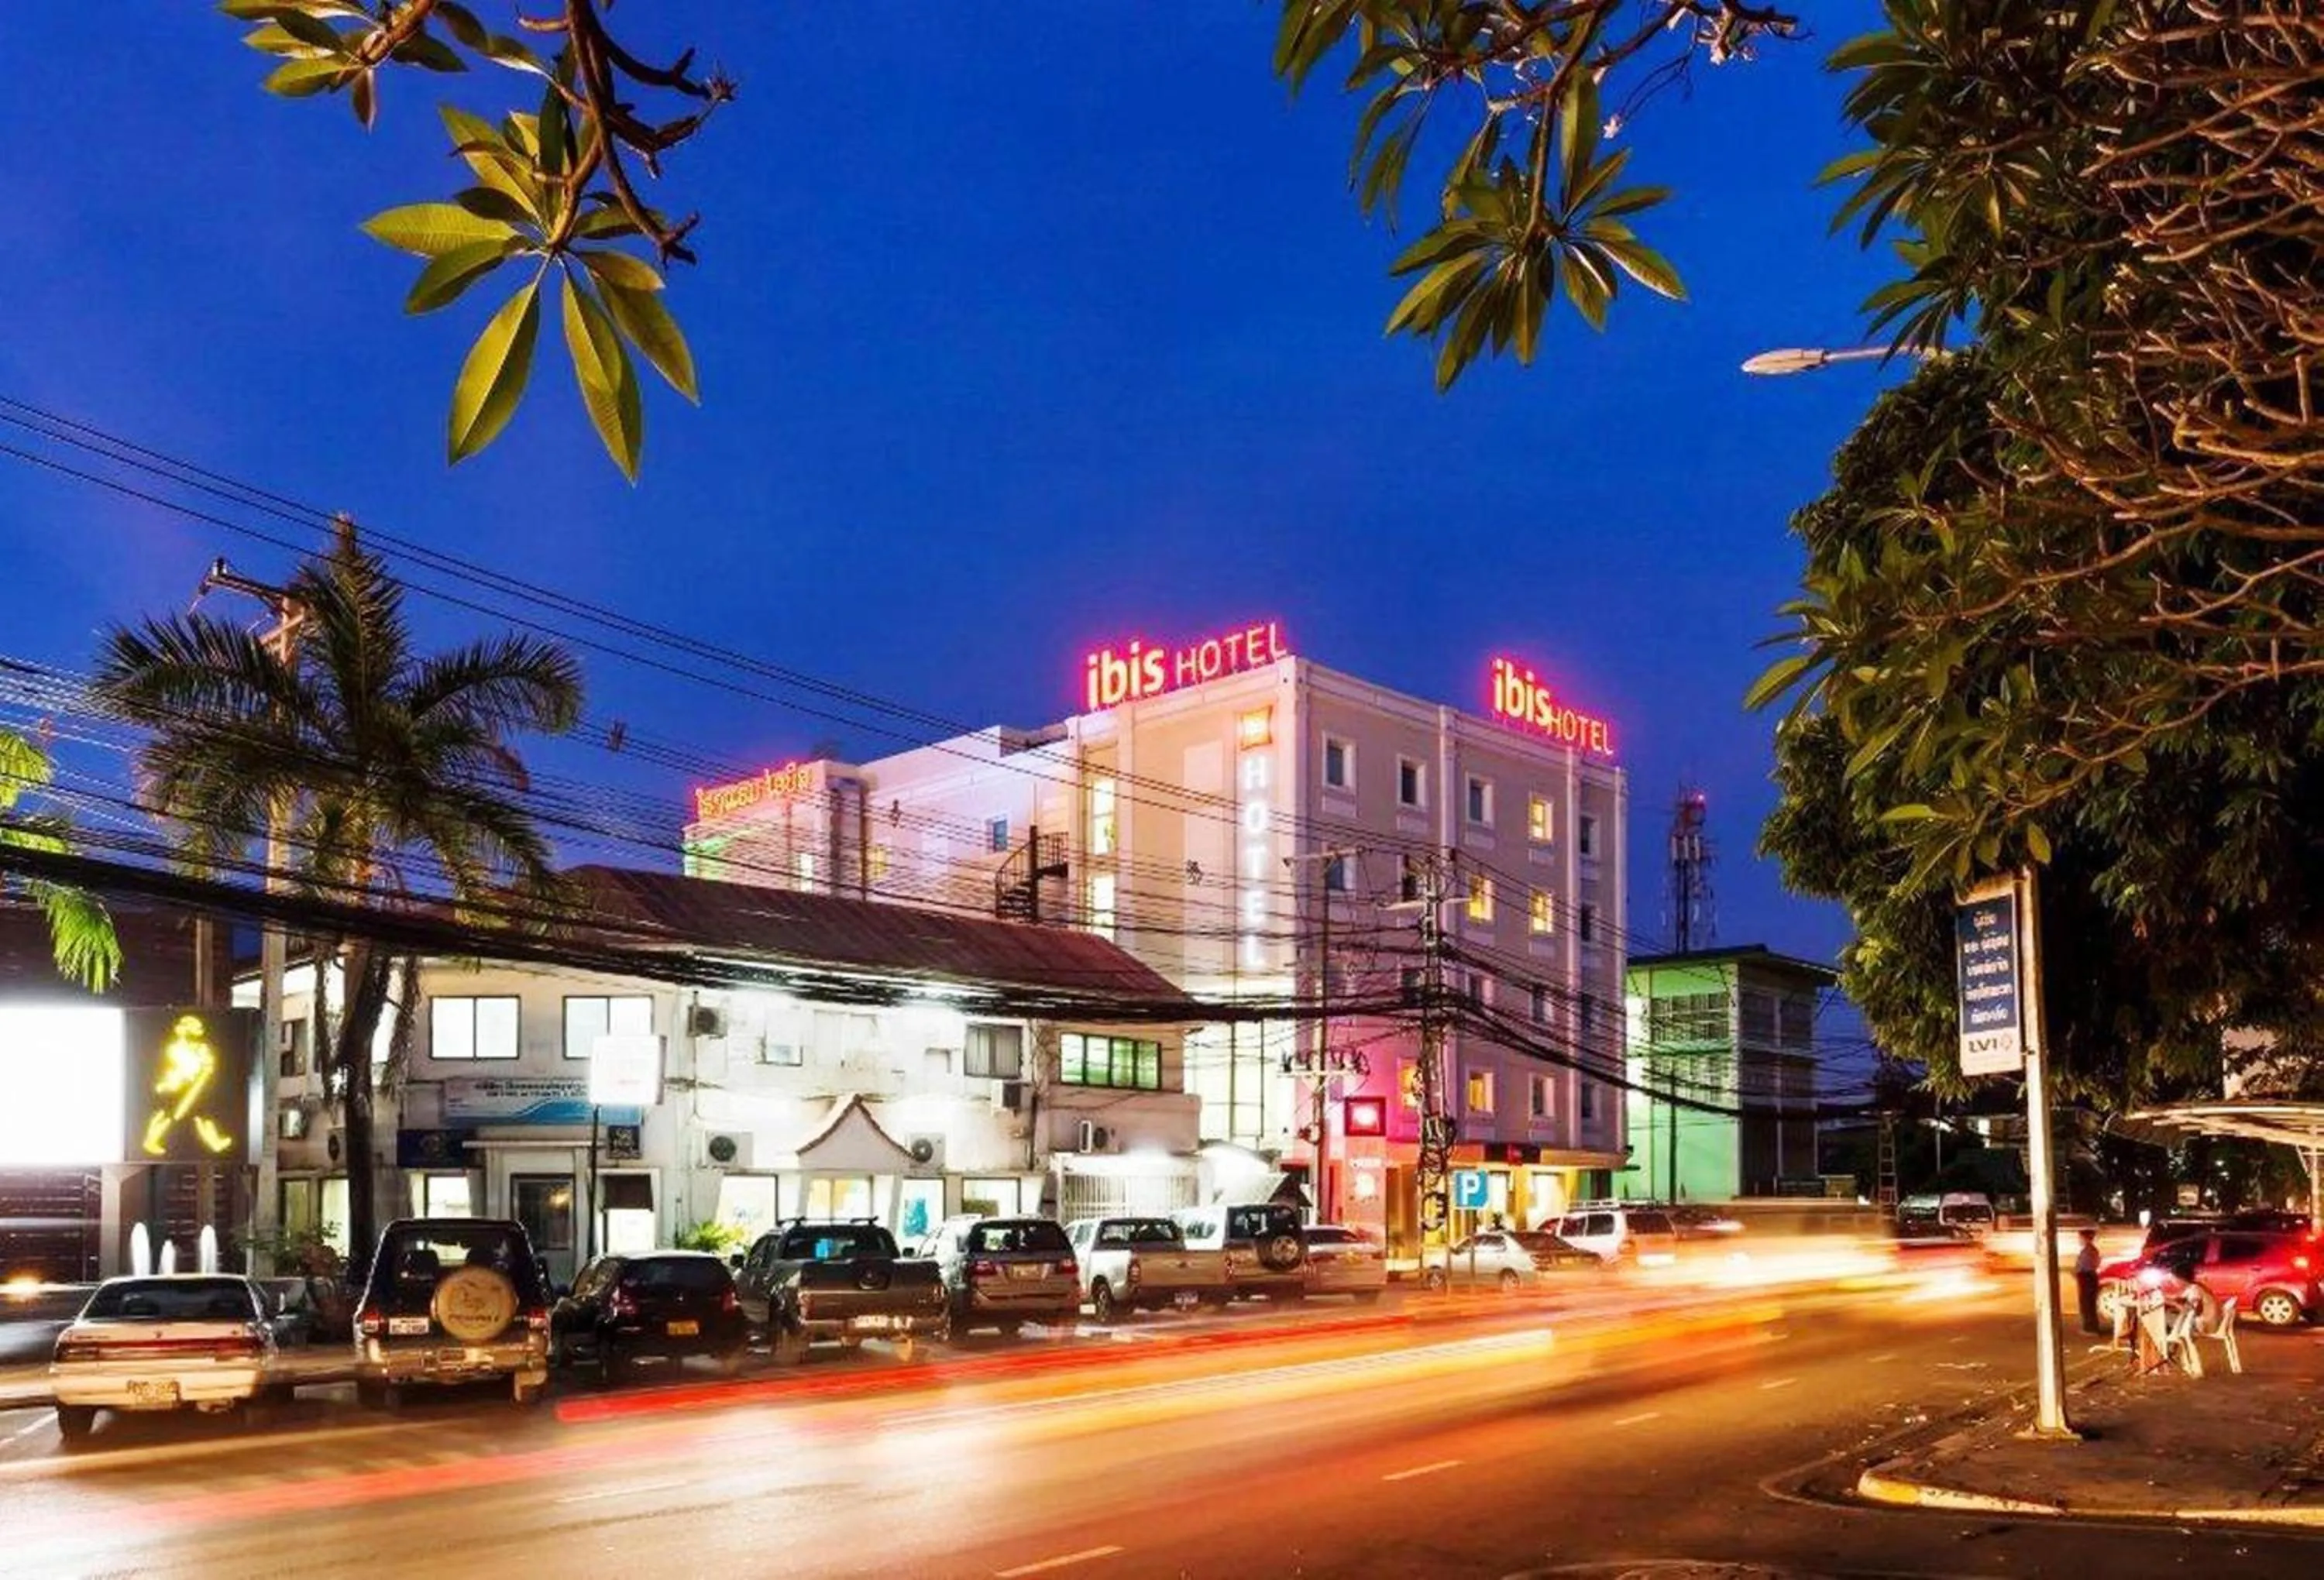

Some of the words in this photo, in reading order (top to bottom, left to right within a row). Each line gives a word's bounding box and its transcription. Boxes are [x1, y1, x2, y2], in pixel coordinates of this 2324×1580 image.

[1087, 641, 1165, 710] ibis
[1176, 621, 1287, 687] HOTEL
[1493, 658, 1551, 727] ibis
[1547, 705, 1614, 756] HOTEL
[1243, 754, 1268, 967] HOTEL
[1460, 1173, 1481, 1205] P
